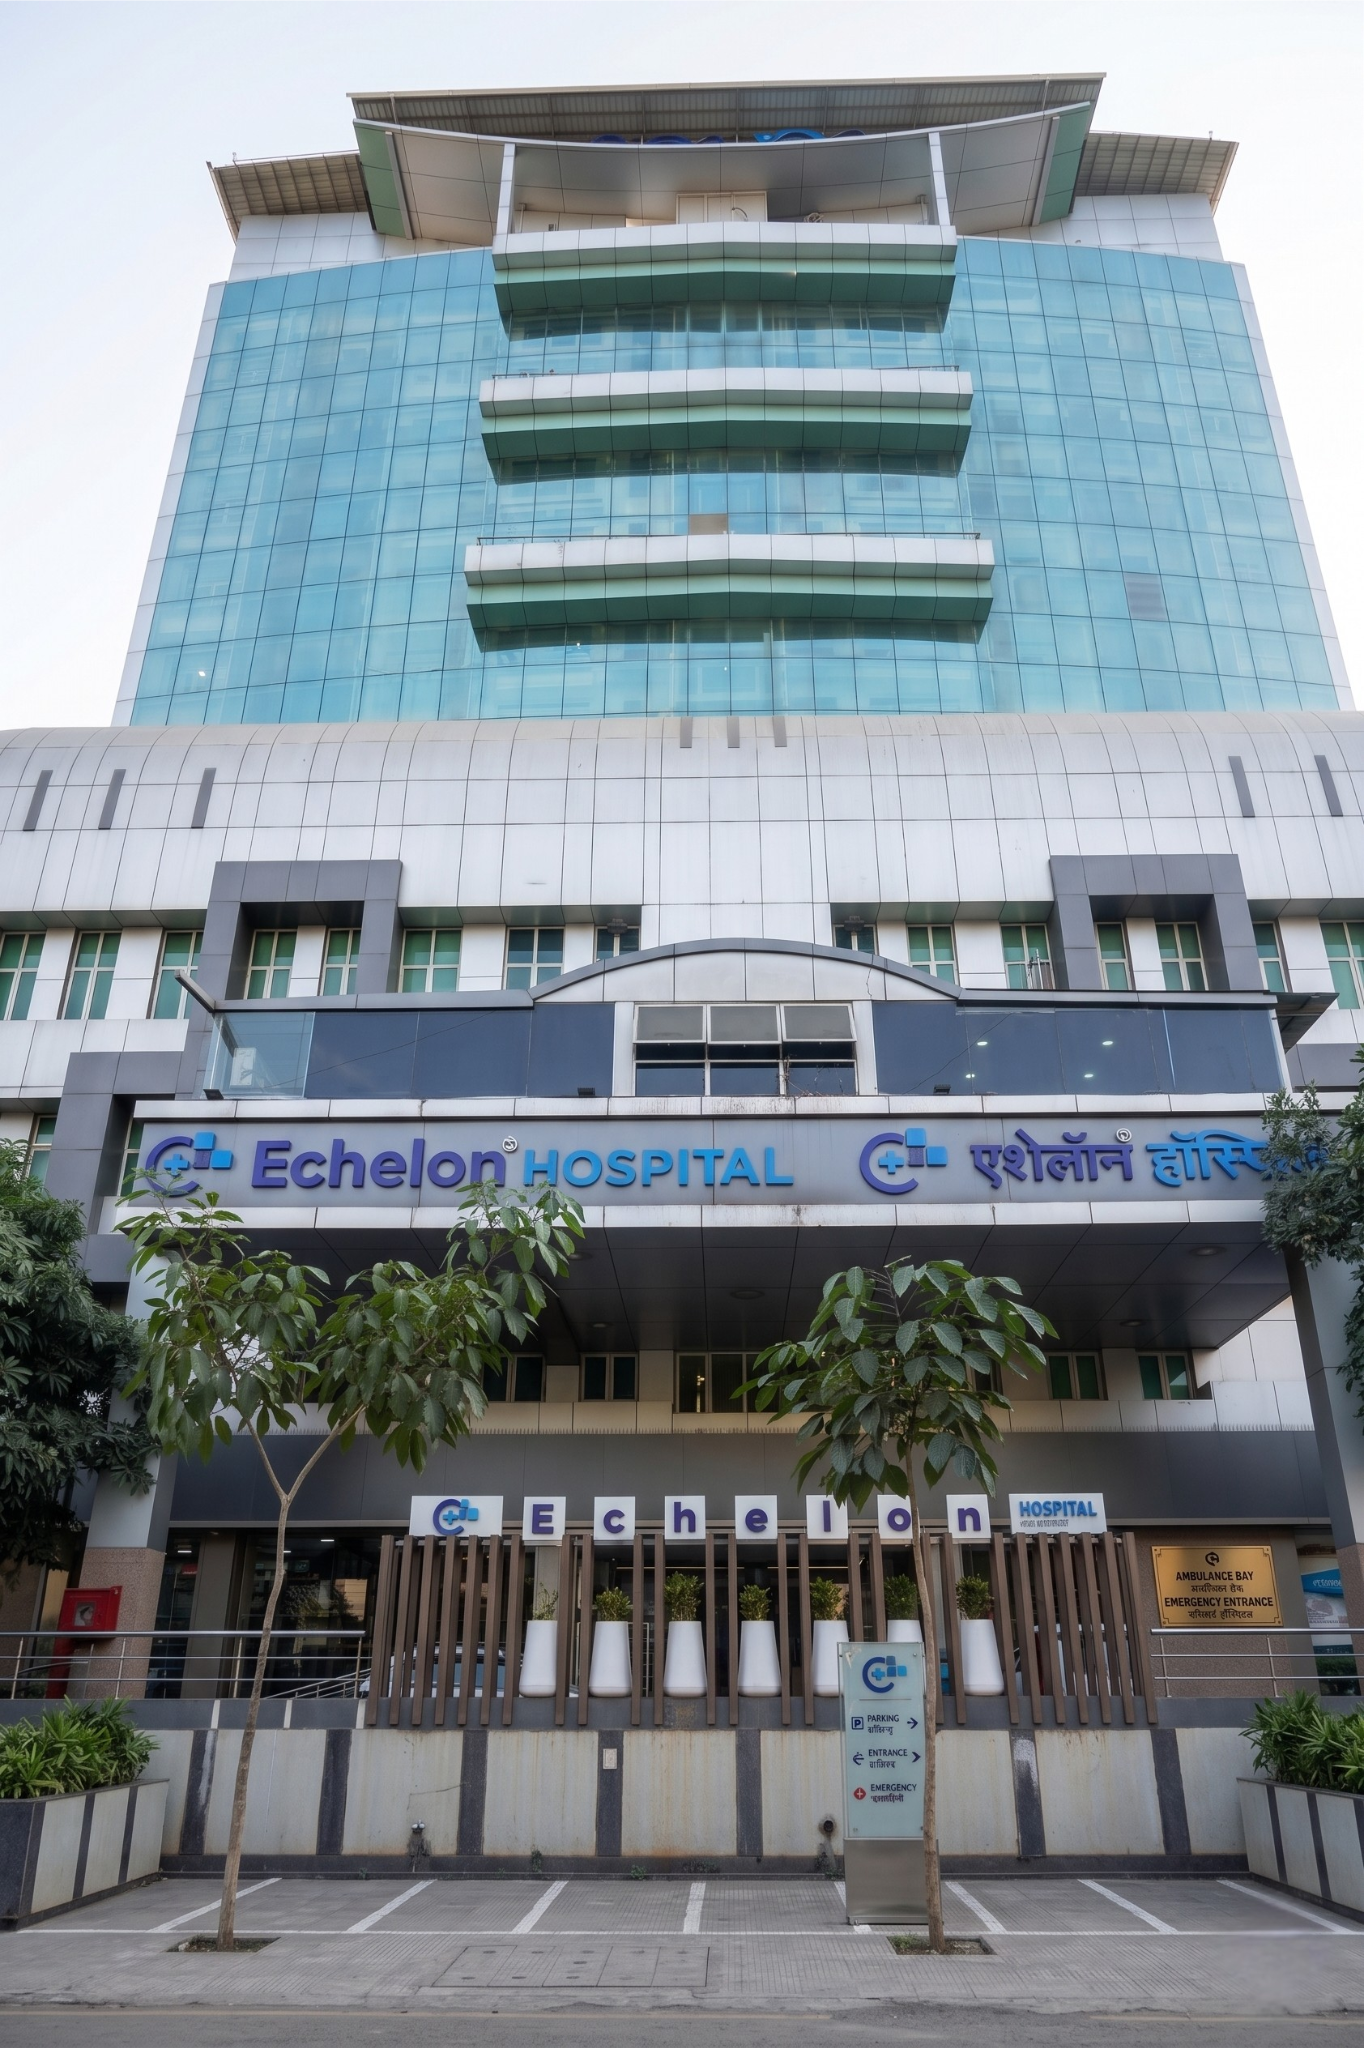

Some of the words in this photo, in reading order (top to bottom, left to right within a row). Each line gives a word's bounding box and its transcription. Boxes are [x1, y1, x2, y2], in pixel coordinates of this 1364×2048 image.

[252, 1138, 505, 1188] Echelon
[523, 1148, 794, 1187] HOSPITAL
[1019, 1500, 1098, 1517] HOSPITAL
[1176, 1571, 1233, 1581] AMBULANCE
[1235, 1571, 1254, 1581] BAY
[1164, 1597, 1221, 1607] EMERGENCY
[1223, 1597, 1274, 1607] ENTRANCE
[867, 1714, 900, 1722] PARKING
